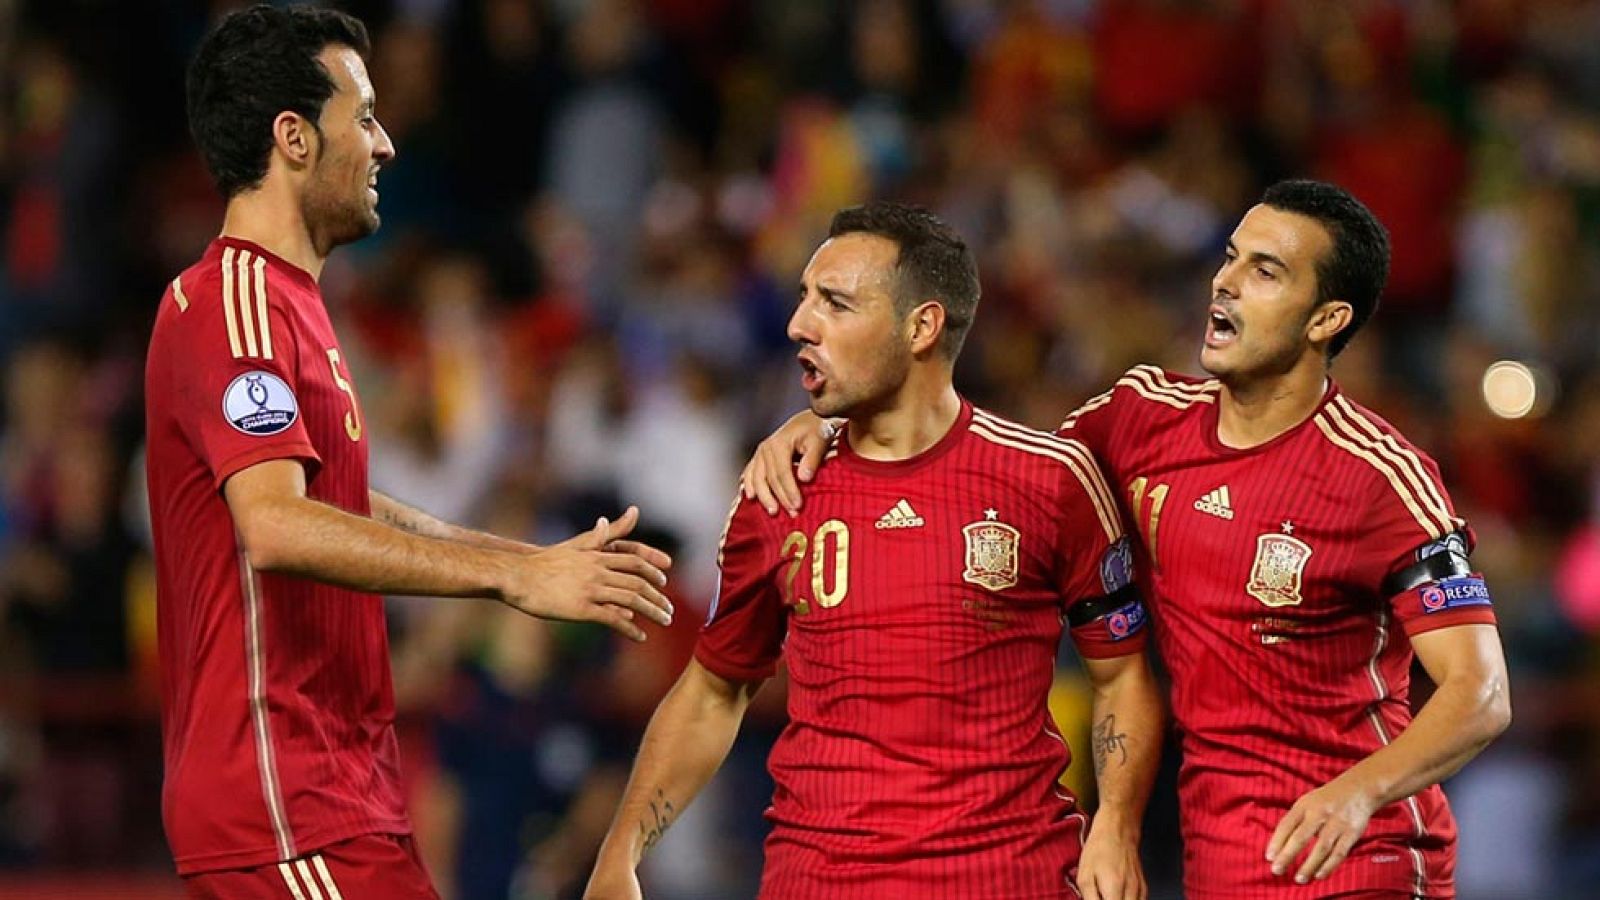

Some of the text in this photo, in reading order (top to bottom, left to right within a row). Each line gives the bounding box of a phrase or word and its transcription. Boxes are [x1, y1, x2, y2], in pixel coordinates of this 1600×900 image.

[326, 348, 361, 442] 5
[874, 516, 925, 529] adidas
[1128, 477, 1169, 566] 11
[1194, 500, 1235, 521] adidas
[781, 518, 849, 615] 20
